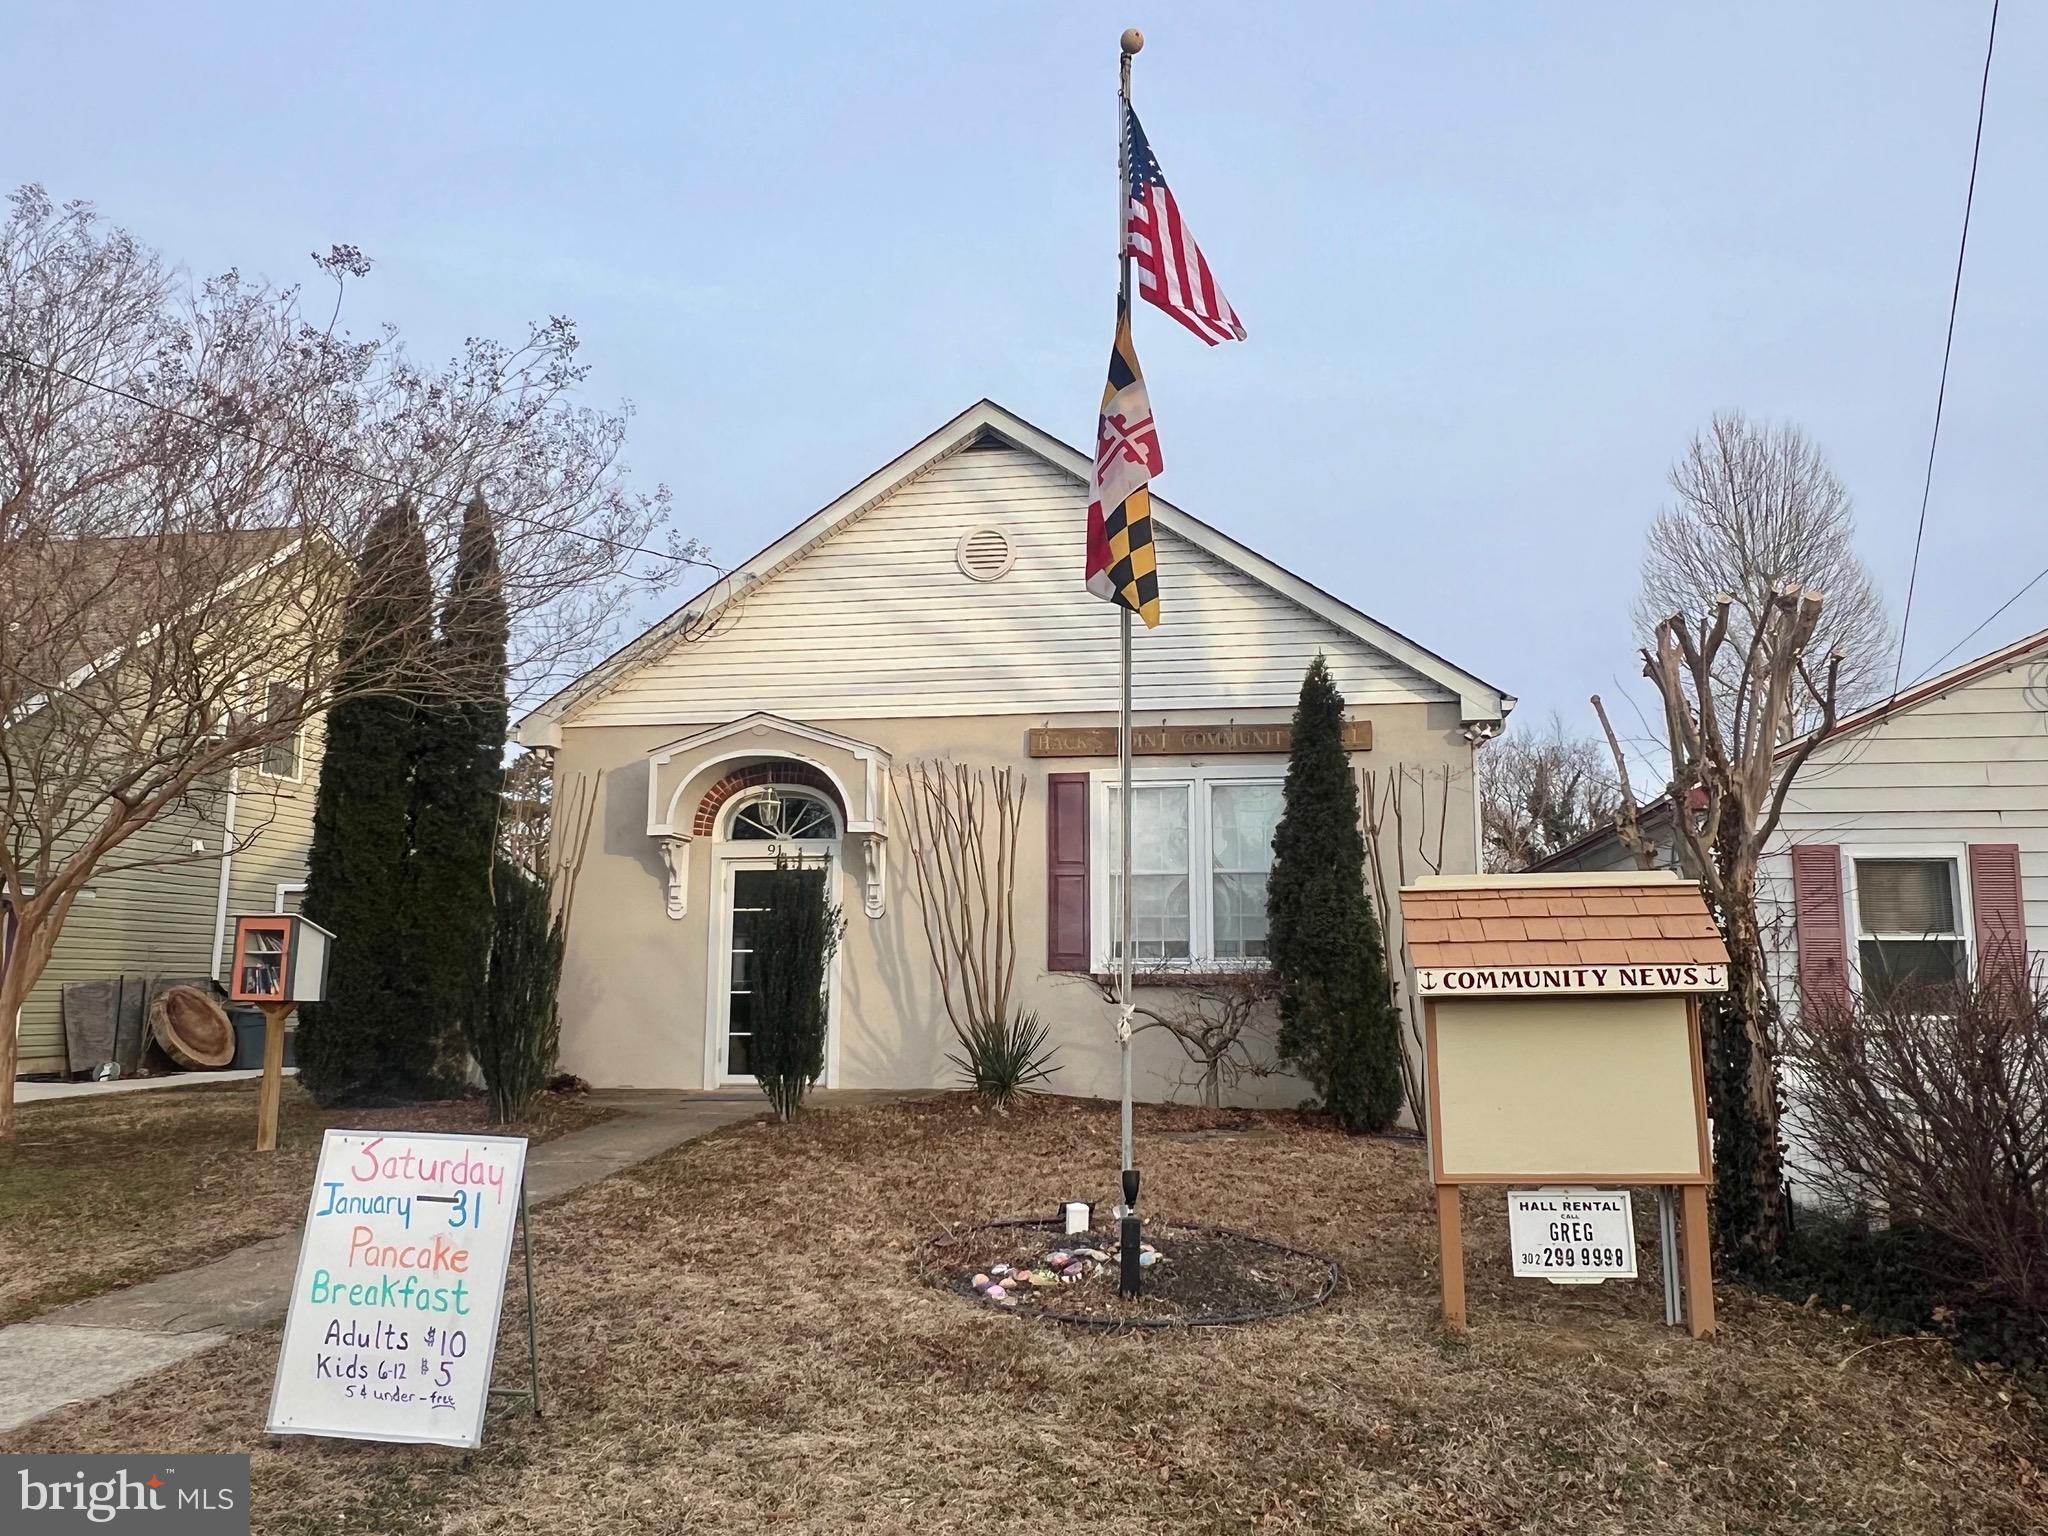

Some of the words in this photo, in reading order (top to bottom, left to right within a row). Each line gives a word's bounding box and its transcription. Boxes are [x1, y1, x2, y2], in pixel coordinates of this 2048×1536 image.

[1181, 730, 1293, 748] COMMUNIT
[1443, 968, 1608, 989] COMMUNITY
[1619, 967, 1699, 987] NEWS
[351, 1137, 505, 1205] Saturday
[316, 1182, 411, 1229] January
[448, 1189, 482, 1229] 31
[1519, 1202, 1557, 1212] HALL
[1563, 1202, 1621, 1212] RENTAL
[1549, 1222, 1594, 1244] GREG
[349, 1225, 470, 1273] Pancake
[1521, 1253, 1541, 1266] 302
[1543, 1247, 1575, 1267] 299
[310, 1269, 471, 1316] Breakfast
[324, 1318, 410, 1350] Adults
[423, 1326, 467, 1358] $10
[316, 1353, 369, 1379] Kids
[377, 1360, 407, 1380] 6-12
[345, 1385, 358, 1399] 5
[373, 1386, 416, 1403] under
